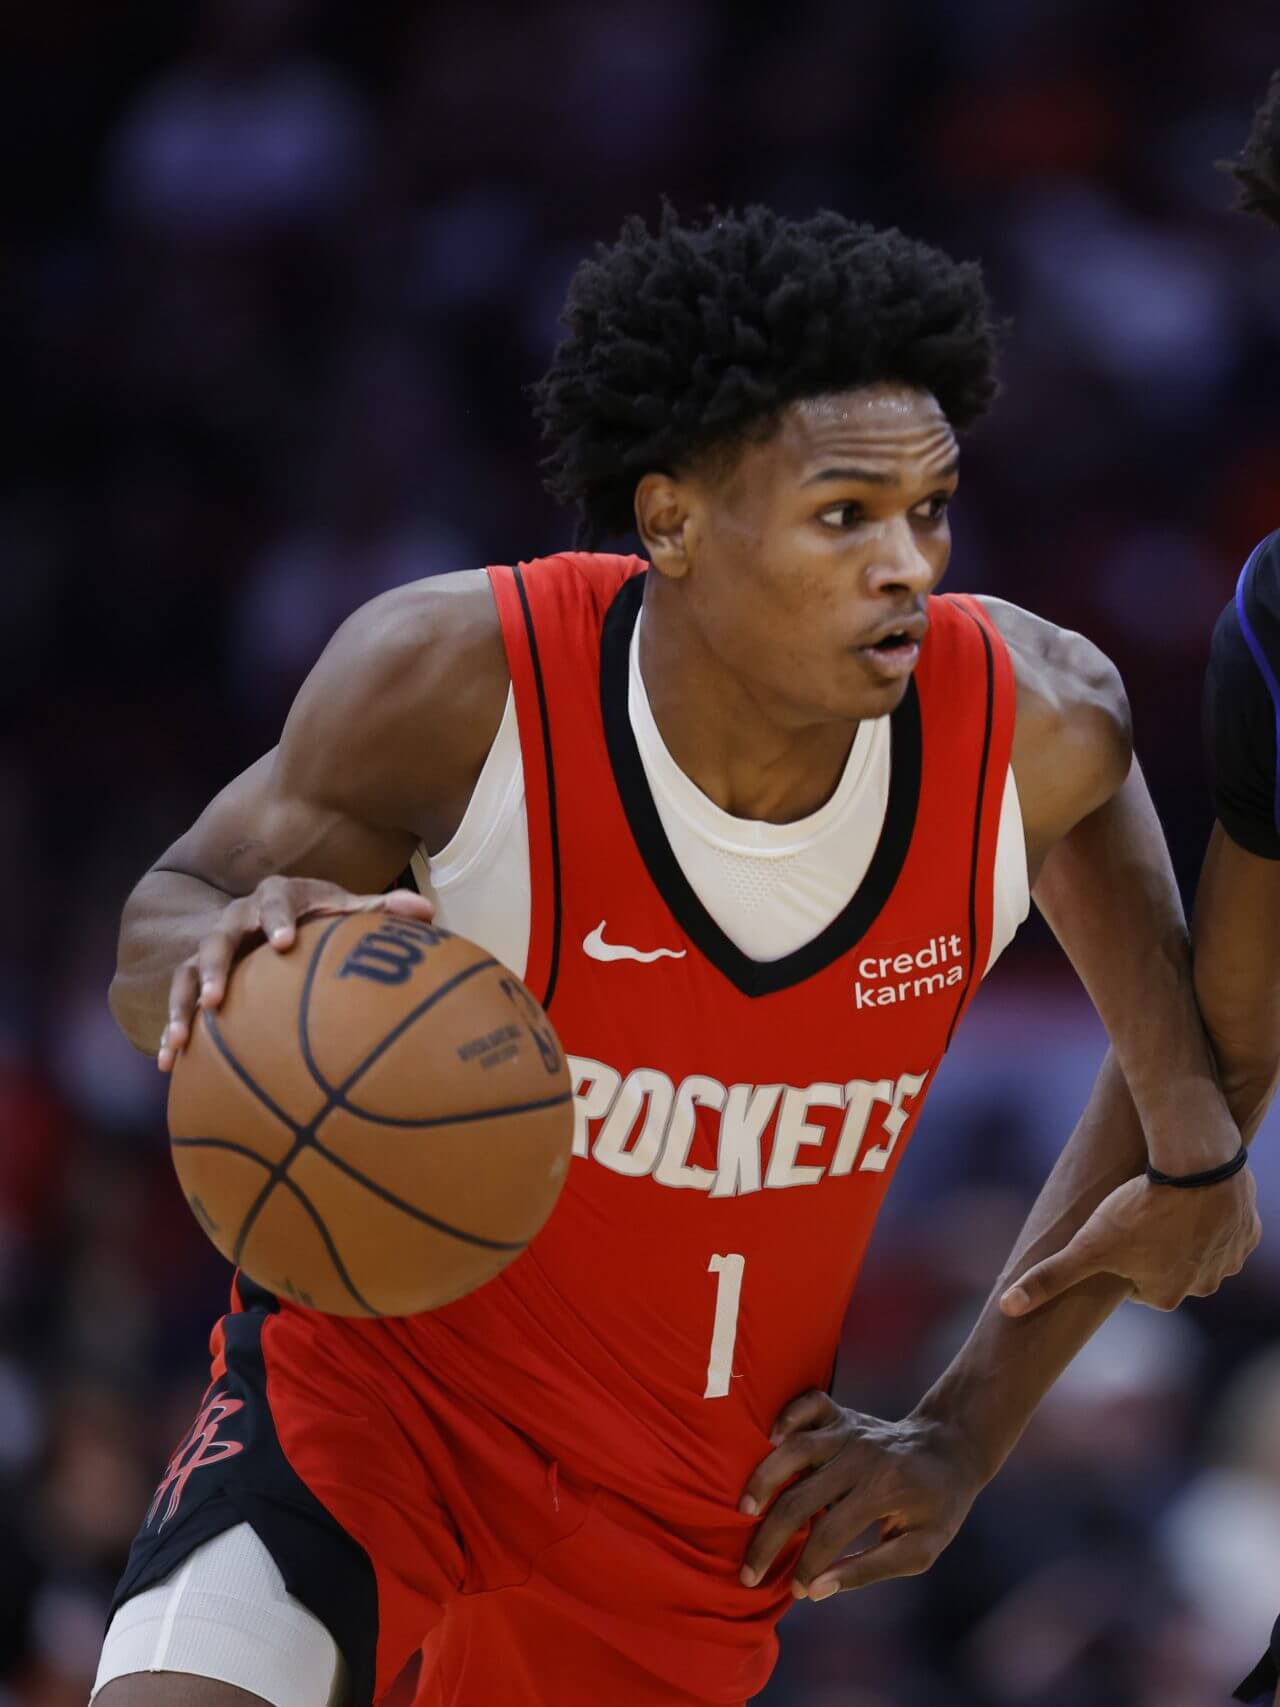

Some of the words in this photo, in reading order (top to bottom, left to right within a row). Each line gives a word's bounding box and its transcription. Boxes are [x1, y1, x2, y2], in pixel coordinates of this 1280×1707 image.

[855, 965, 963, 1009] karma
[858, 933, 962, 979] credit
[565, 1054, 930, 1199] ROCKETS
[703, 1252, 745, 1400] 1
